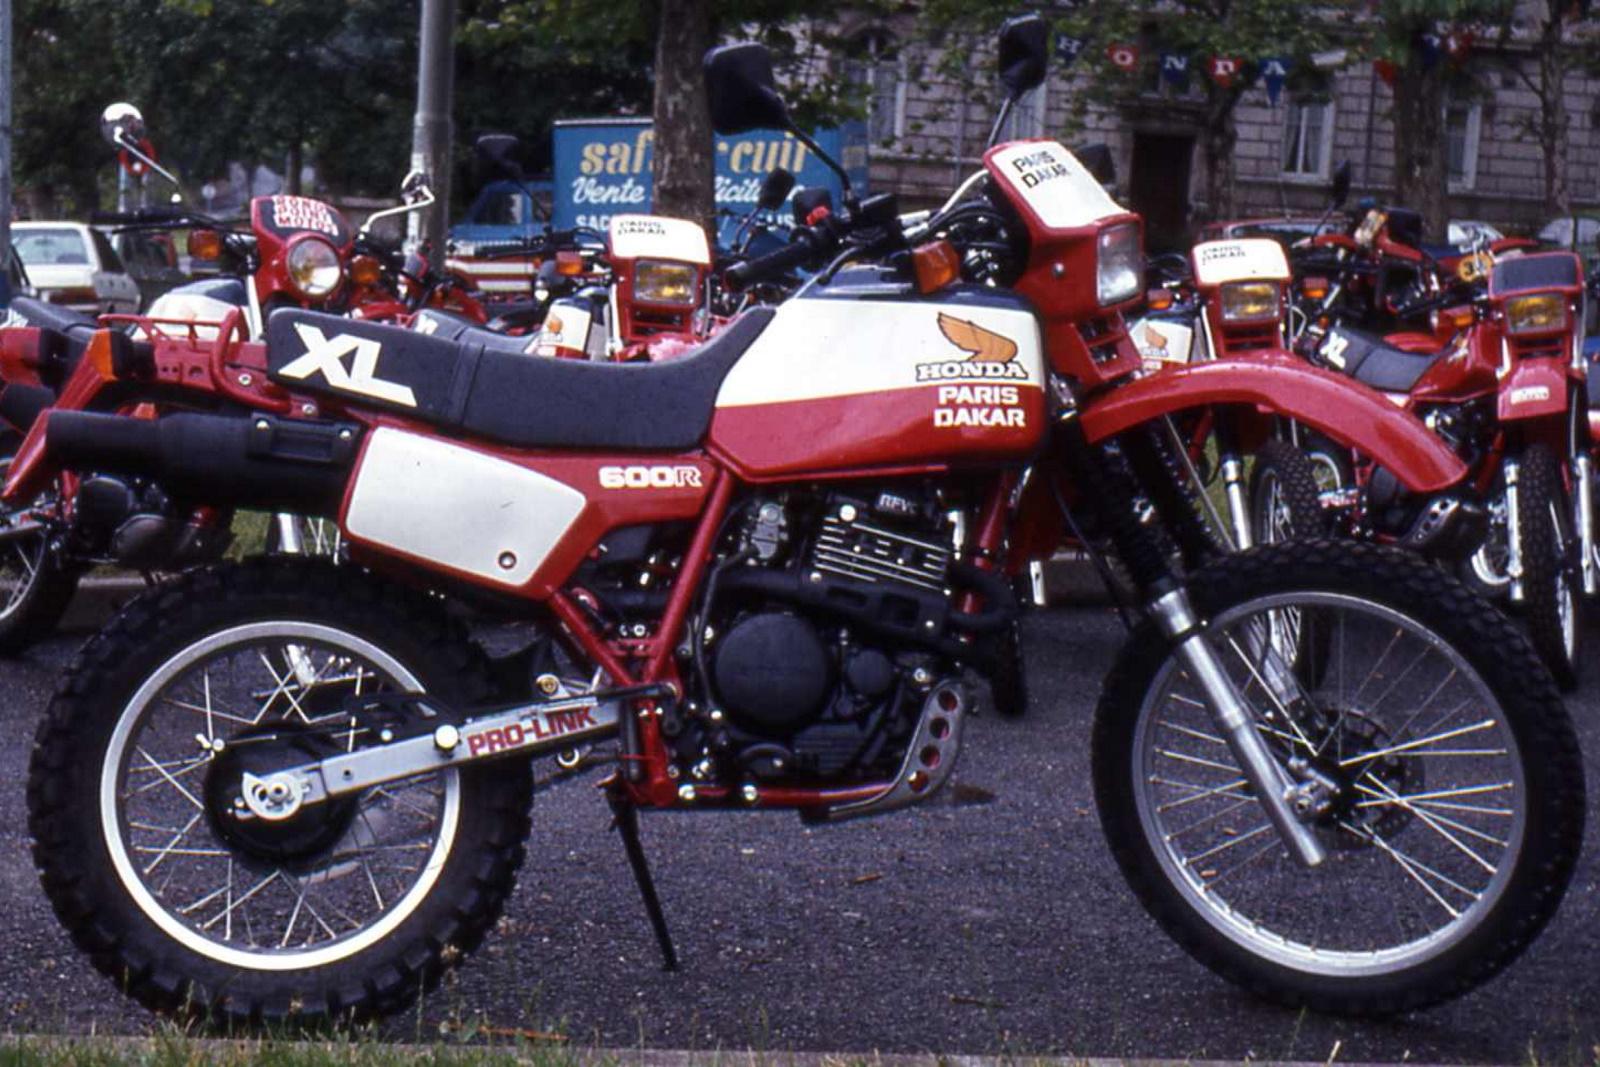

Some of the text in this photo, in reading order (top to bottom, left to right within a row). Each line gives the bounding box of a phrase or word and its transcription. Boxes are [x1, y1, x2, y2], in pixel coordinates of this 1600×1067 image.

[1011, 150, 1056, 173] PARIS
[1021, 163, 1072, 189] DAKAR
[572, 176, 646, 204] Vente
[1320, 330, 1348, 369] XL
[277, 321, 418, 408] XL
[915, 360, 1028, 382] HONDA
[937, 386, 1019, 405] PARIS
[933, 408, 1026, 427] DAKAR
[598, 466, 702, 489] 600R
[466, 706, 597, 756] PRO-LINK
